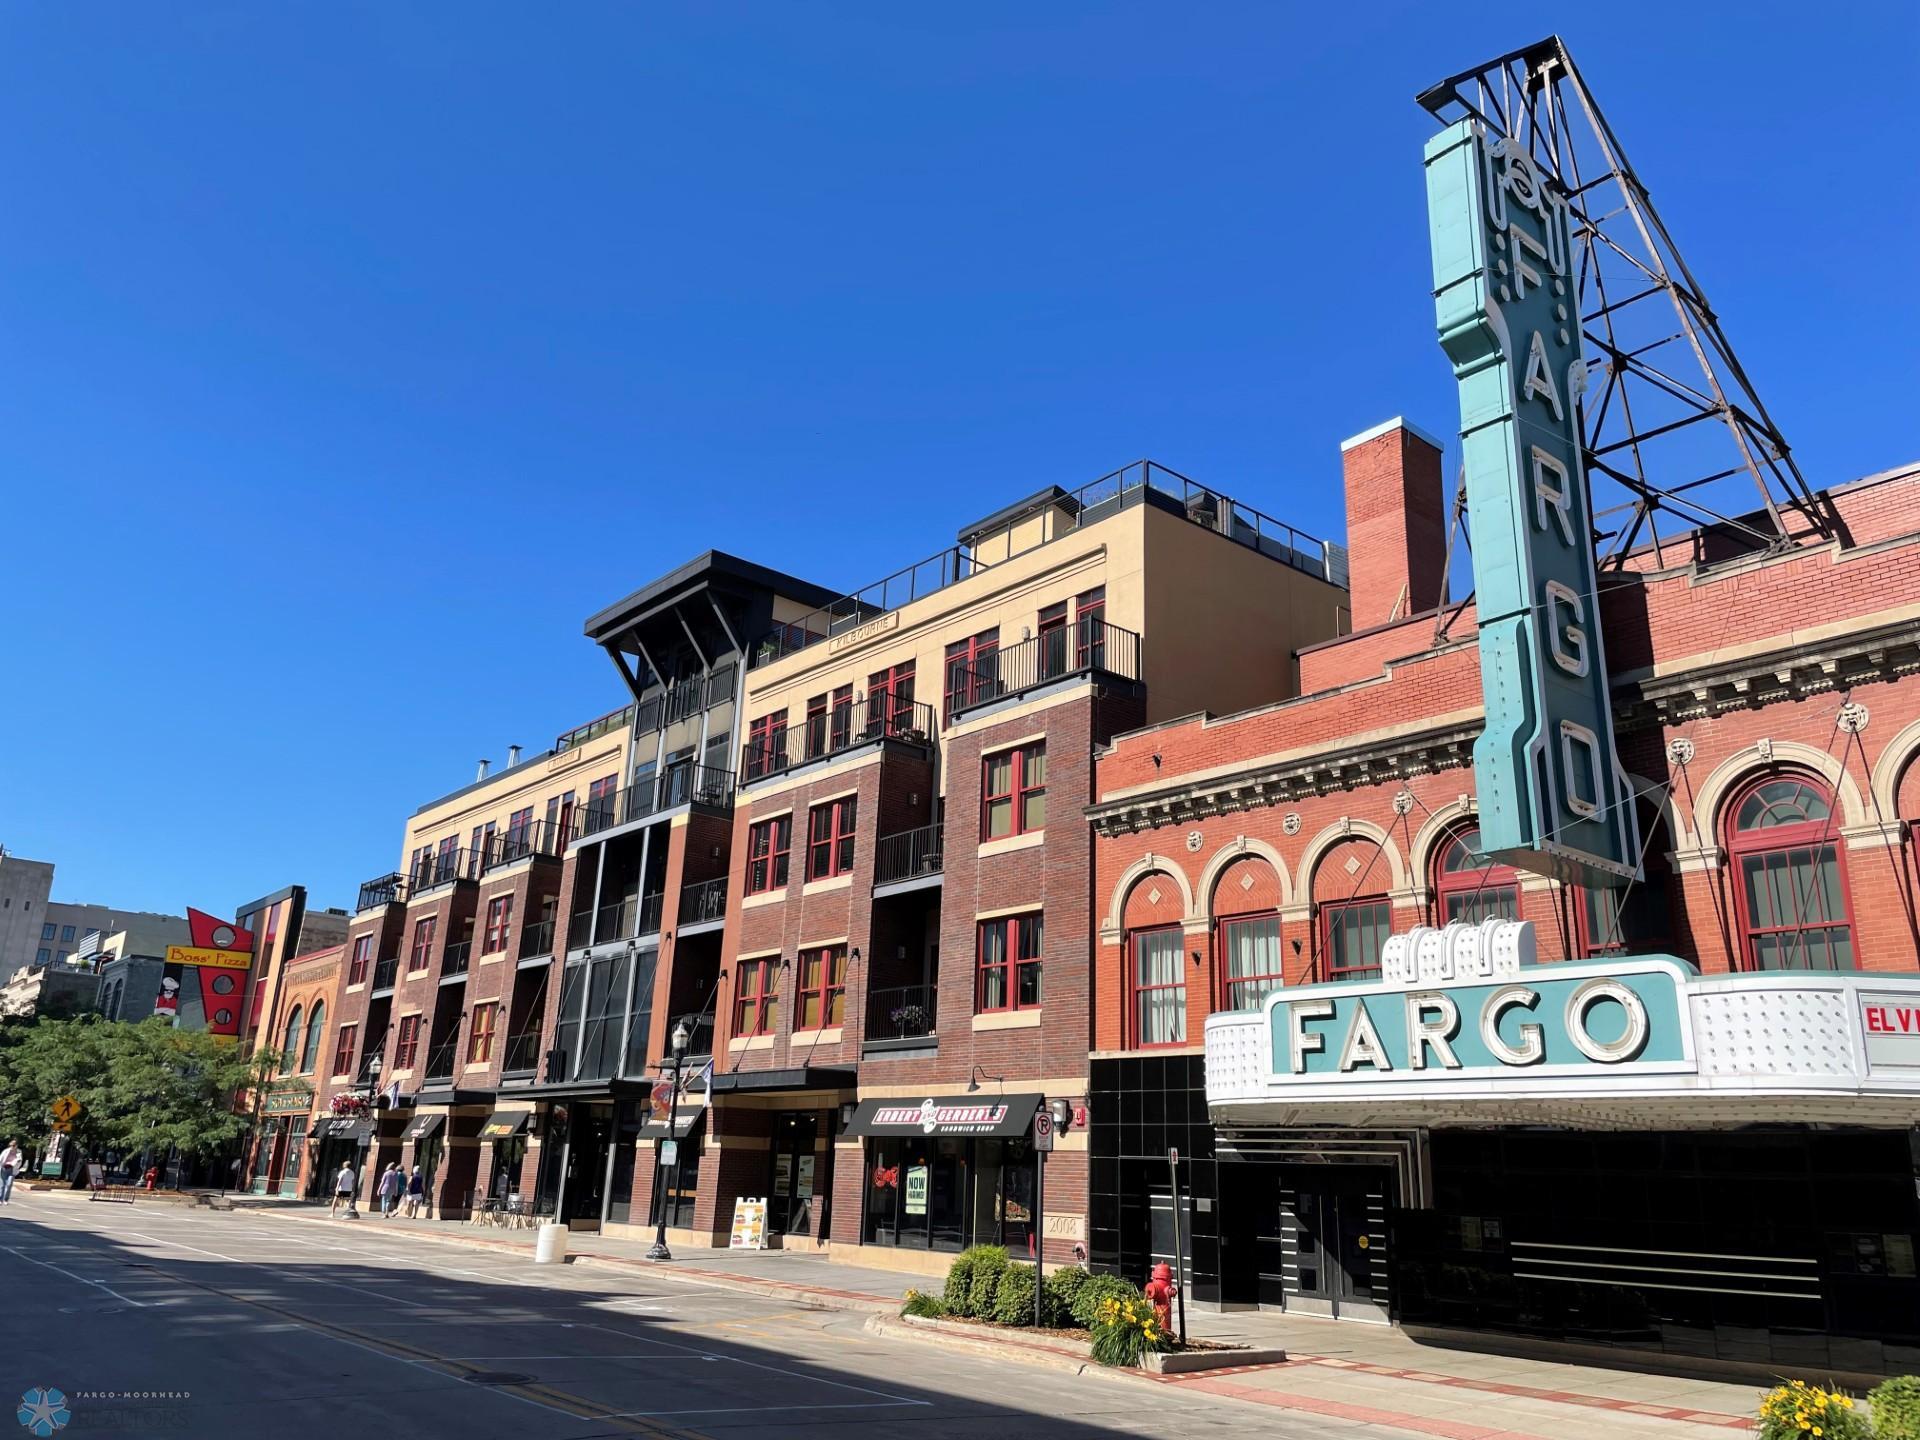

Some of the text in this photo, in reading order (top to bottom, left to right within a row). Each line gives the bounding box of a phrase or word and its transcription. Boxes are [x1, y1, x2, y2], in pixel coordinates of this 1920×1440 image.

[1509, 222, 1606, 824] FARGO
[215, 952, 247, 967] Pizza
[1288, 977, 1652, 1074] FARGO
[937, 1109, 1003, 1121] GERBERTS
[909, 1177, 926, 1190] NOW
[1049, 1217, 1077, 1234] 2008
